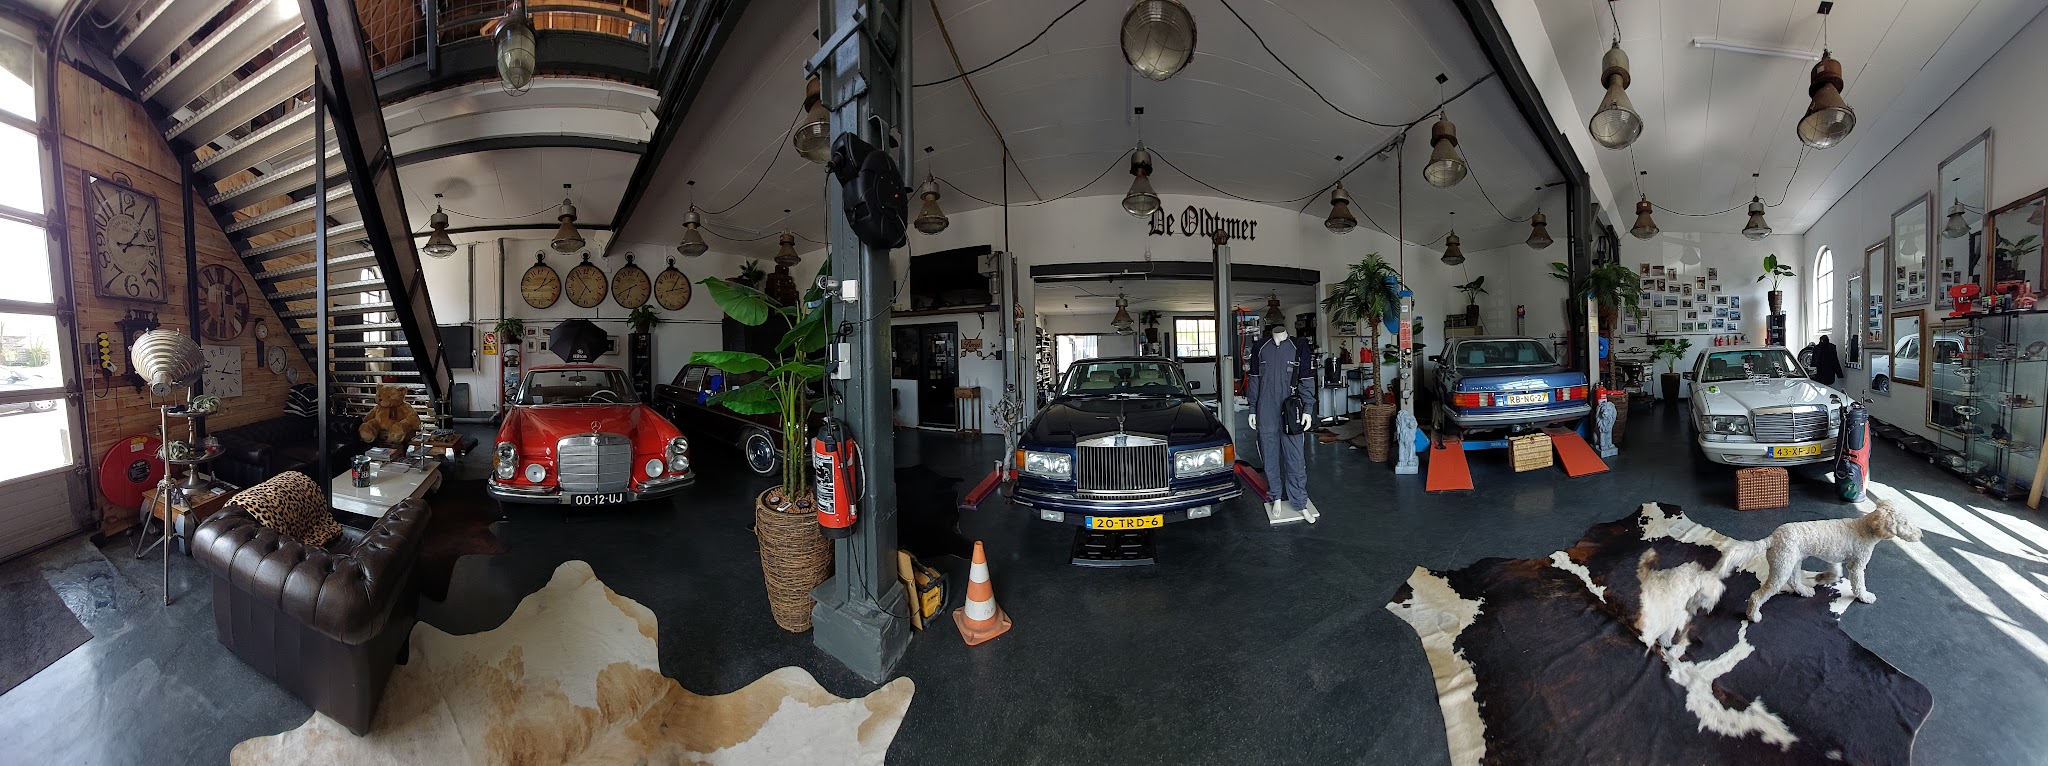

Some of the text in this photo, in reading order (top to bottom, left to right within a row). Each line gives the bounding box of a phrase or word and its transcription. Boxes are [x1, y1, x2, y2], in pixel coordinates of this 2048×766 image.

[116, 190, 135, 220] 12
[1148, 205, 1175, 237] De
[104, 263, 124, 289] 7
[124, 274, 140, 298] 6
[140, 268, 160, 299] 5
[1509, 395, 1546, 404] RB-NG-27
[575, 493, 623, 505] 00-12-UJ
[1097, 517, 1159, 528] 20-TRD-6
